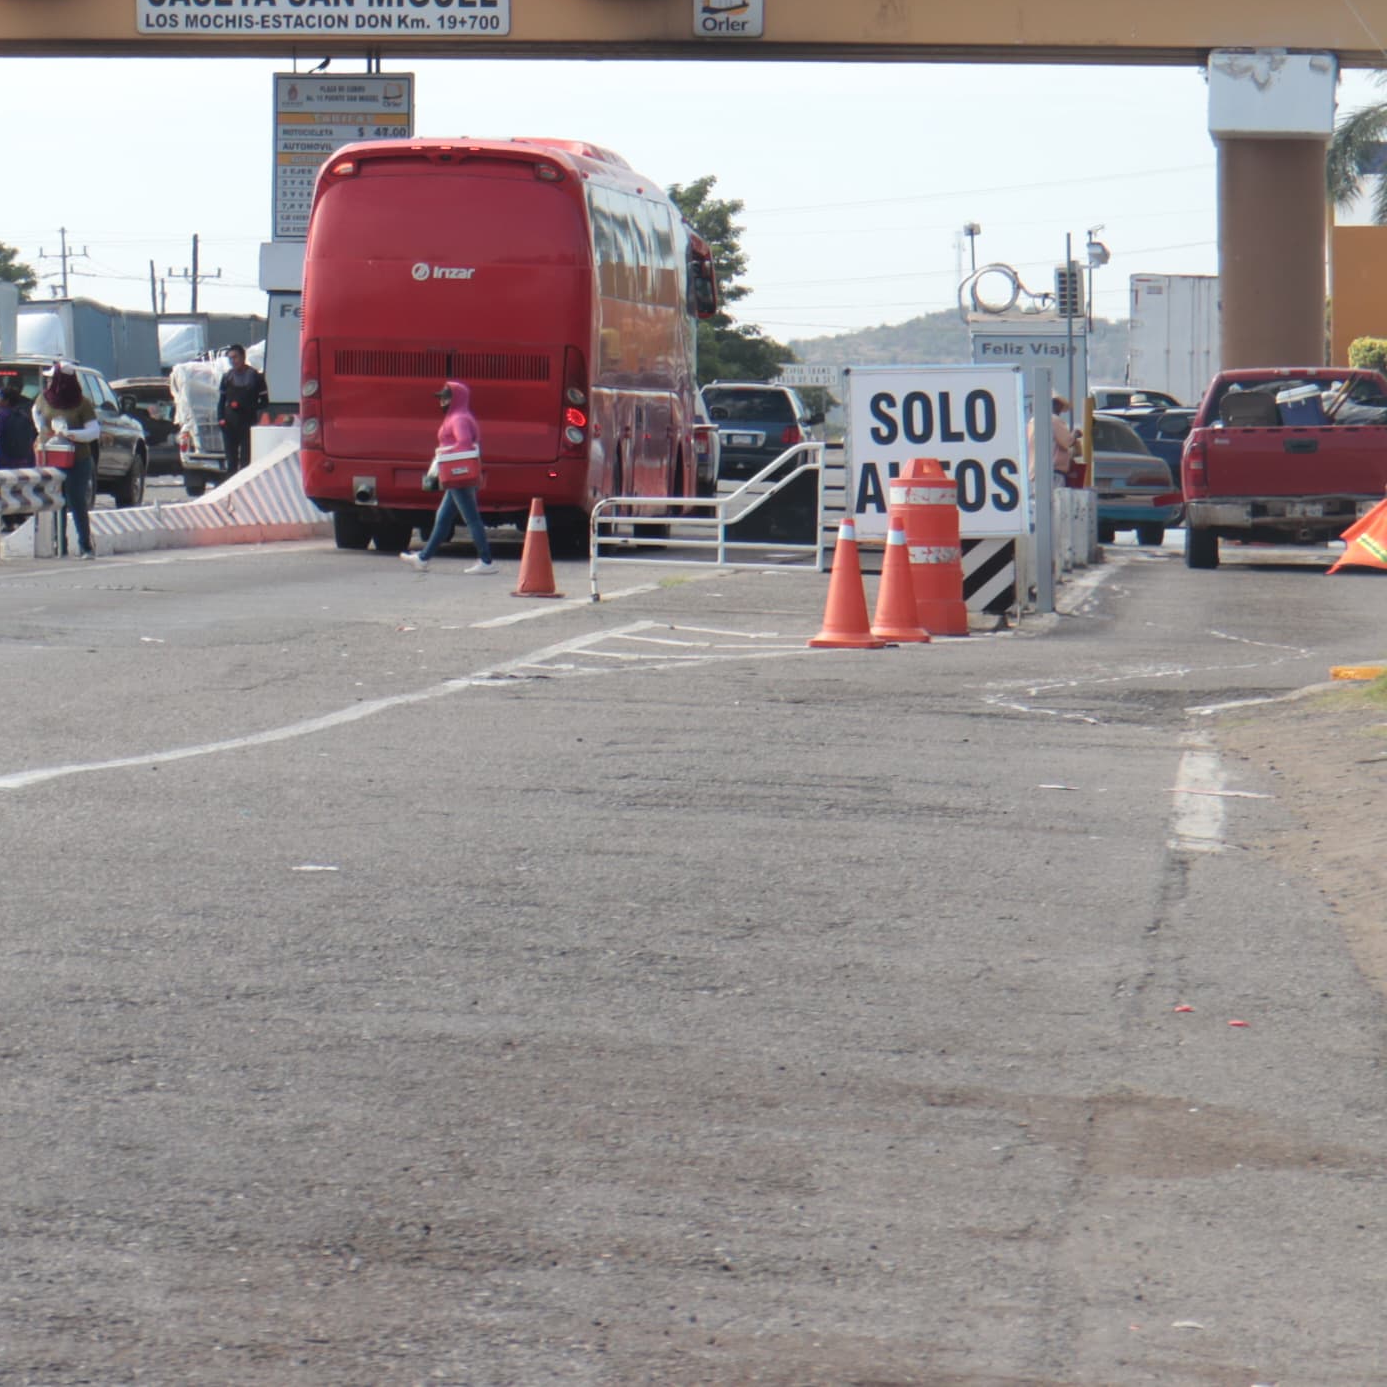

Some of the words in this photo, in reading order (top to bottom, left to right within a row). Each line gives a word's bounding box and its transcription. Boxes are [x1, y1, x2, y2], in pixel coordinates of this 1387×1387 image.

[145, 14, 178, 28] LOS
[185, 14, 349, 29] MOCHIS-ESTACION
[355, 14, 388, 29] DON
[397, 14, 431, 29] Km.
[439, 15, 500, 30] 19+700
[702, 17, 748, 31] Orler
[433, 265, 475, 279] Irizar
[982, 343, 1025, 355] Feliz
[870, 389, 997, 446] SOLO
[855, 458, 1020, 513] AOS
